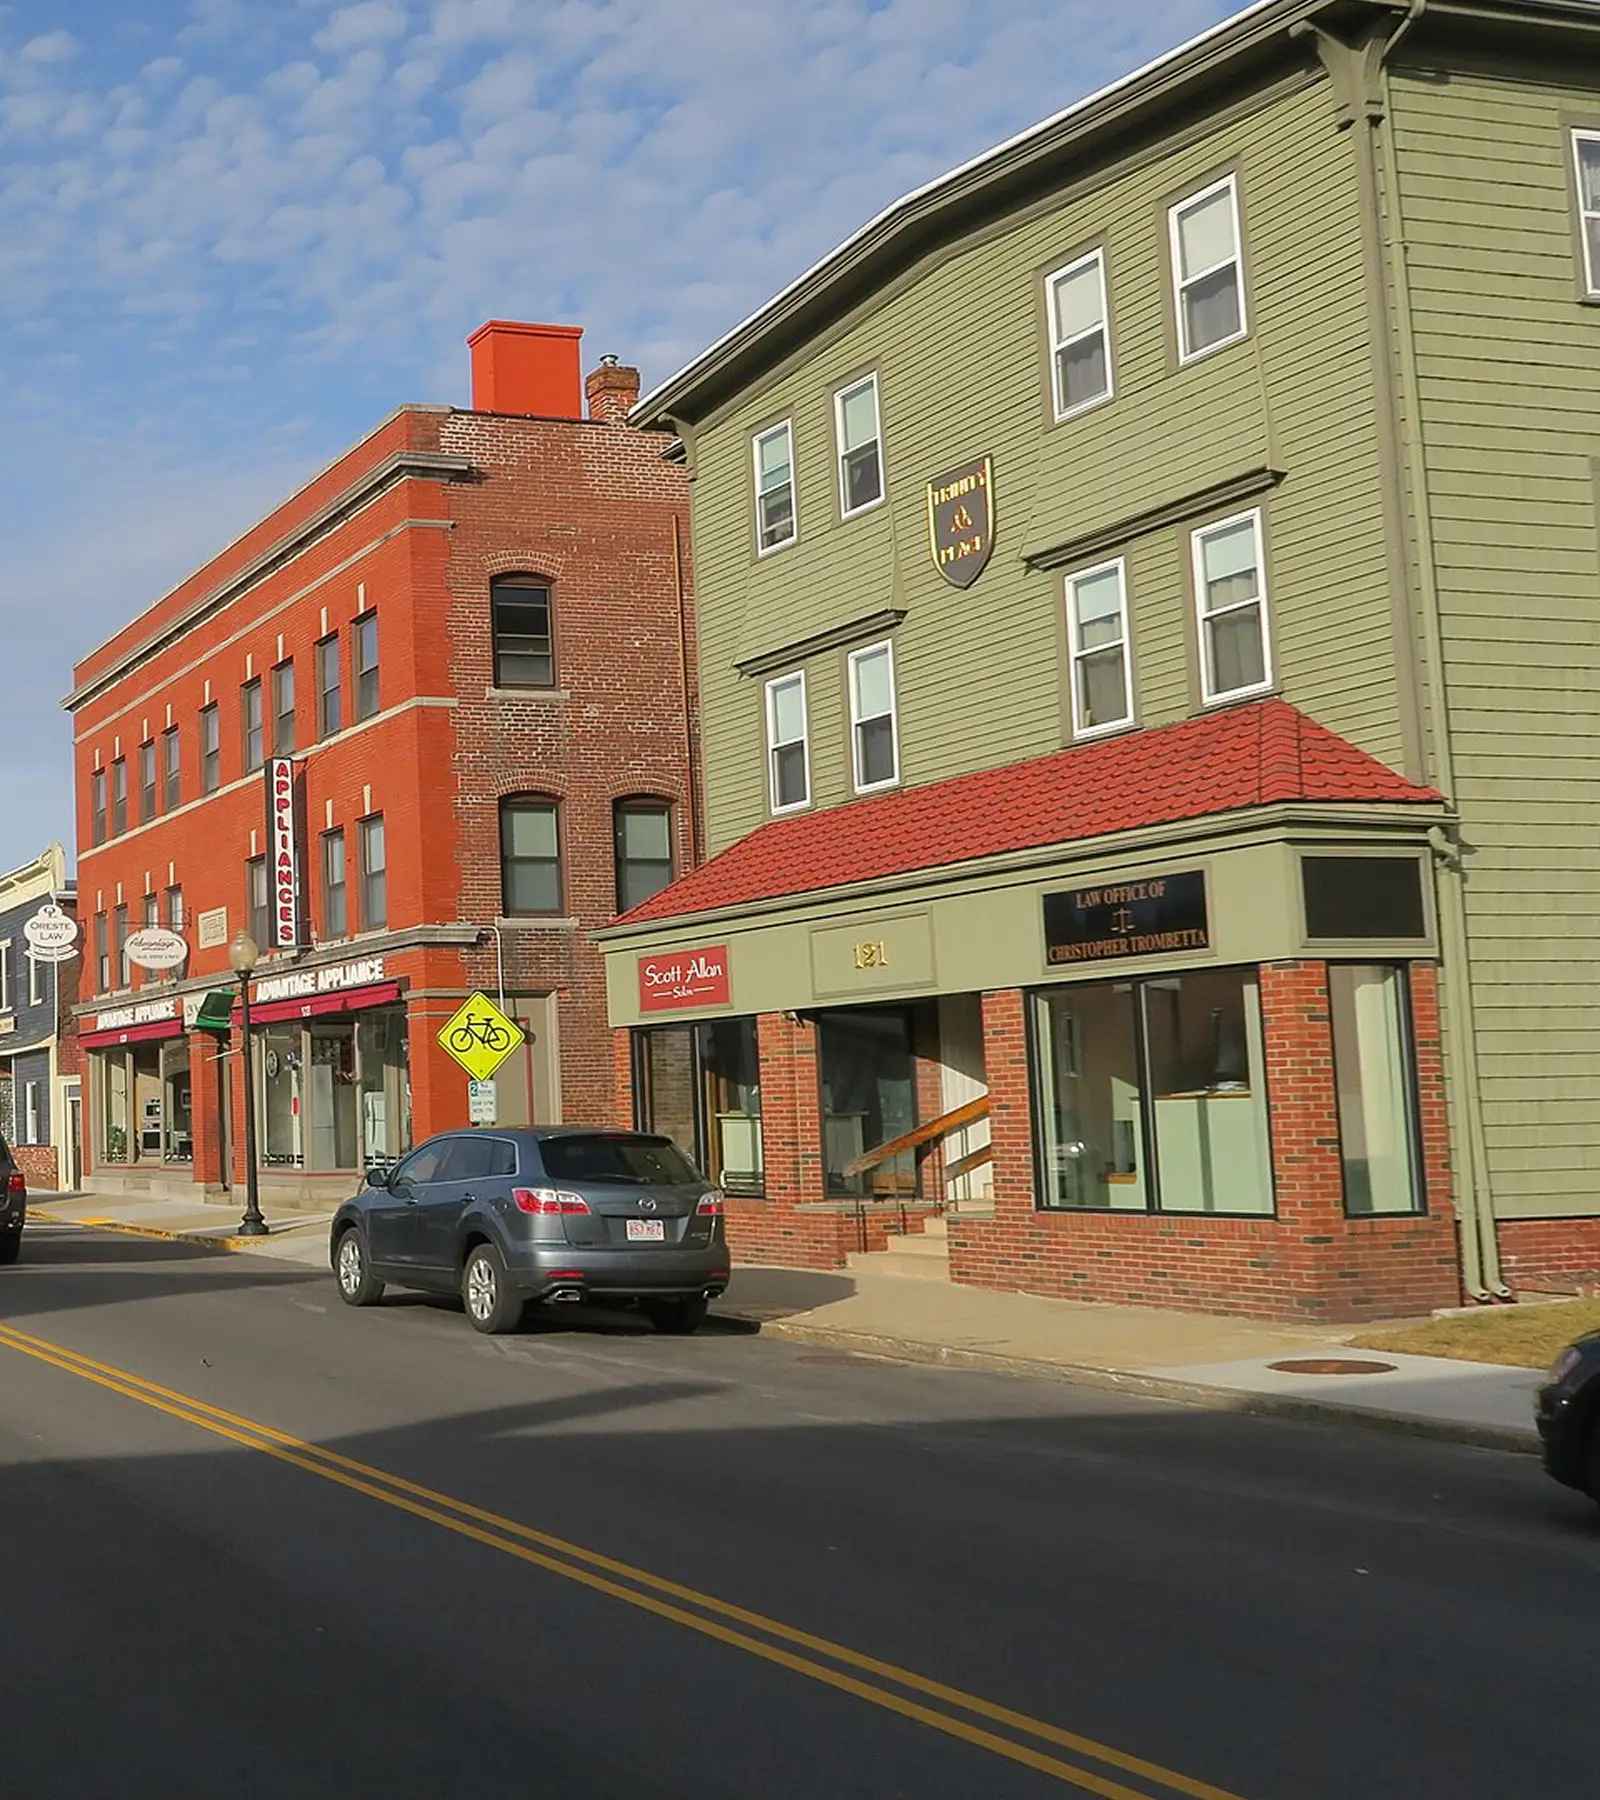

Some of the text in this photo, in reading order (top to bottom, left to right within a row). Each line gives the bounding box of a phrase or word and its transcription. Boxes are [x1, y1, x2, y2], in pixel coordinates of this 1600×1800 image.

[276, 762, 294, 942] APPLIANCES
[1076, 880, 1167, 909] LAW OFFICE OF
[30, 921, 72, 931] ORESTE
[40, 931, 64, 941] LAW
[853, 940, 888, 969] 121
[1049, 928, 1207, 962] CHRISTOPHER TROMBETTA
[256, 958, 385, 1002] ADVANTAGE APPLIANCE
[644, 957, 723, 987] Scott Allan
[135, 999, 175, 1021] APPLIANCE
